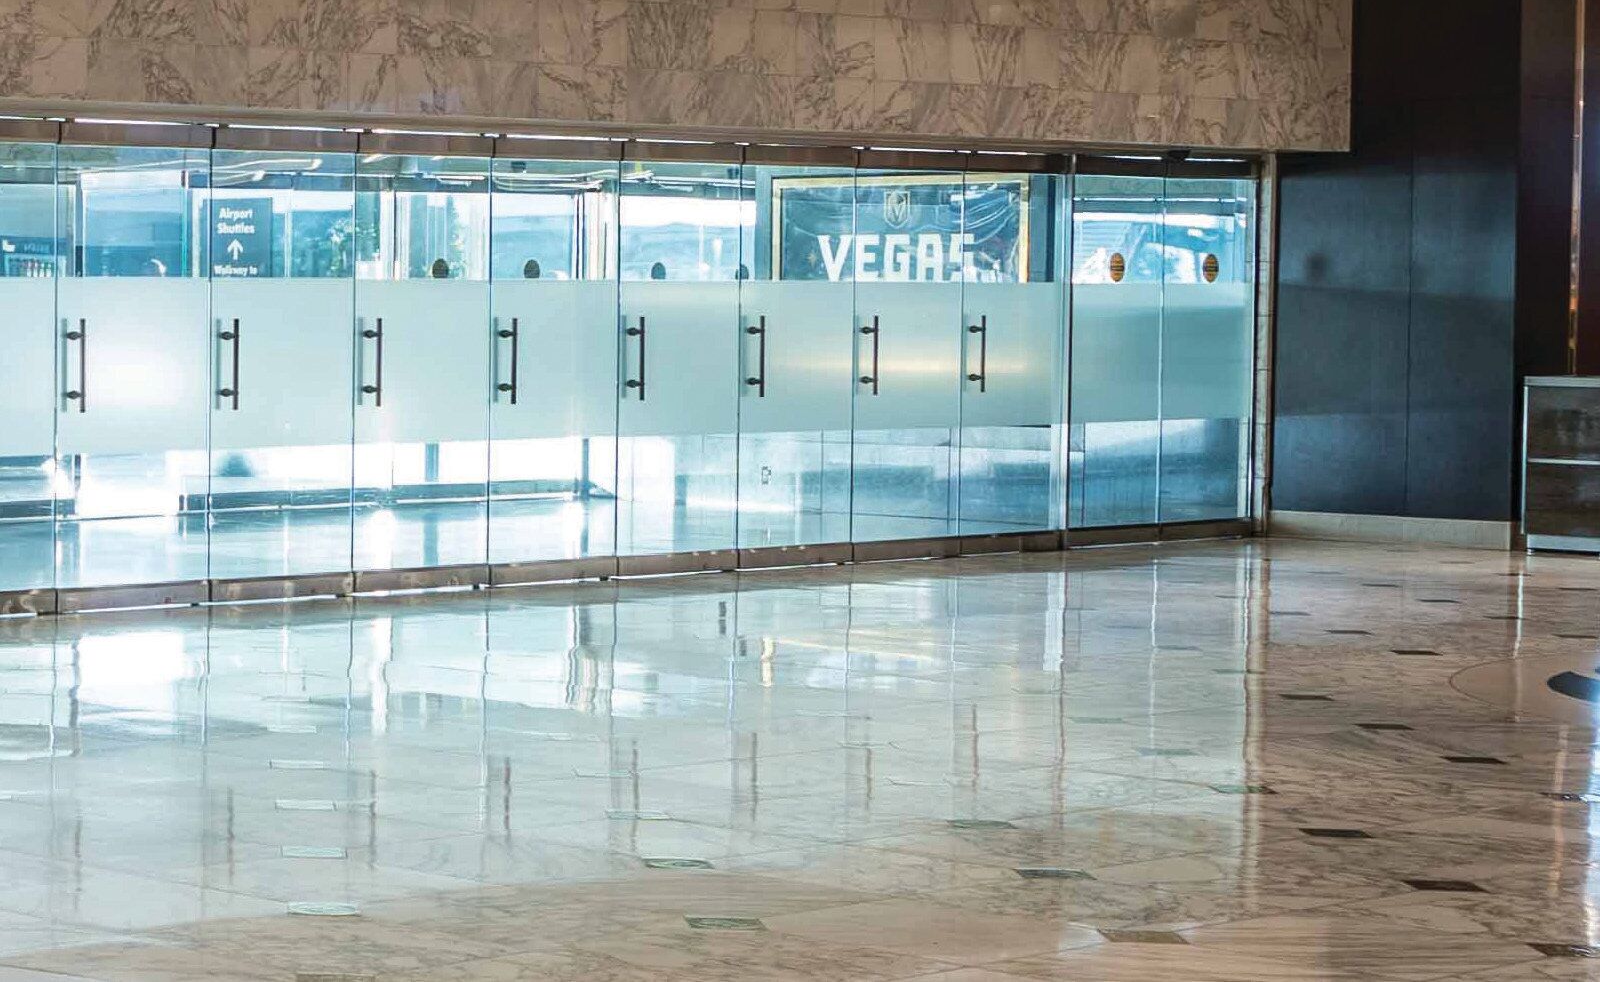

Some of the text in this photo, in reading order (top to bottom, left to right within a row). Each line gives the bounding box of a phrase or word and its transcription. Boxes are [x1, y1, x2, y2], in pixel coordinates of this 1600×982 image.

[218, 207, 254, 222] Airport
[217, 222, 255, 234] Shuttles
[817, 234, 976, 283] VEGAS
